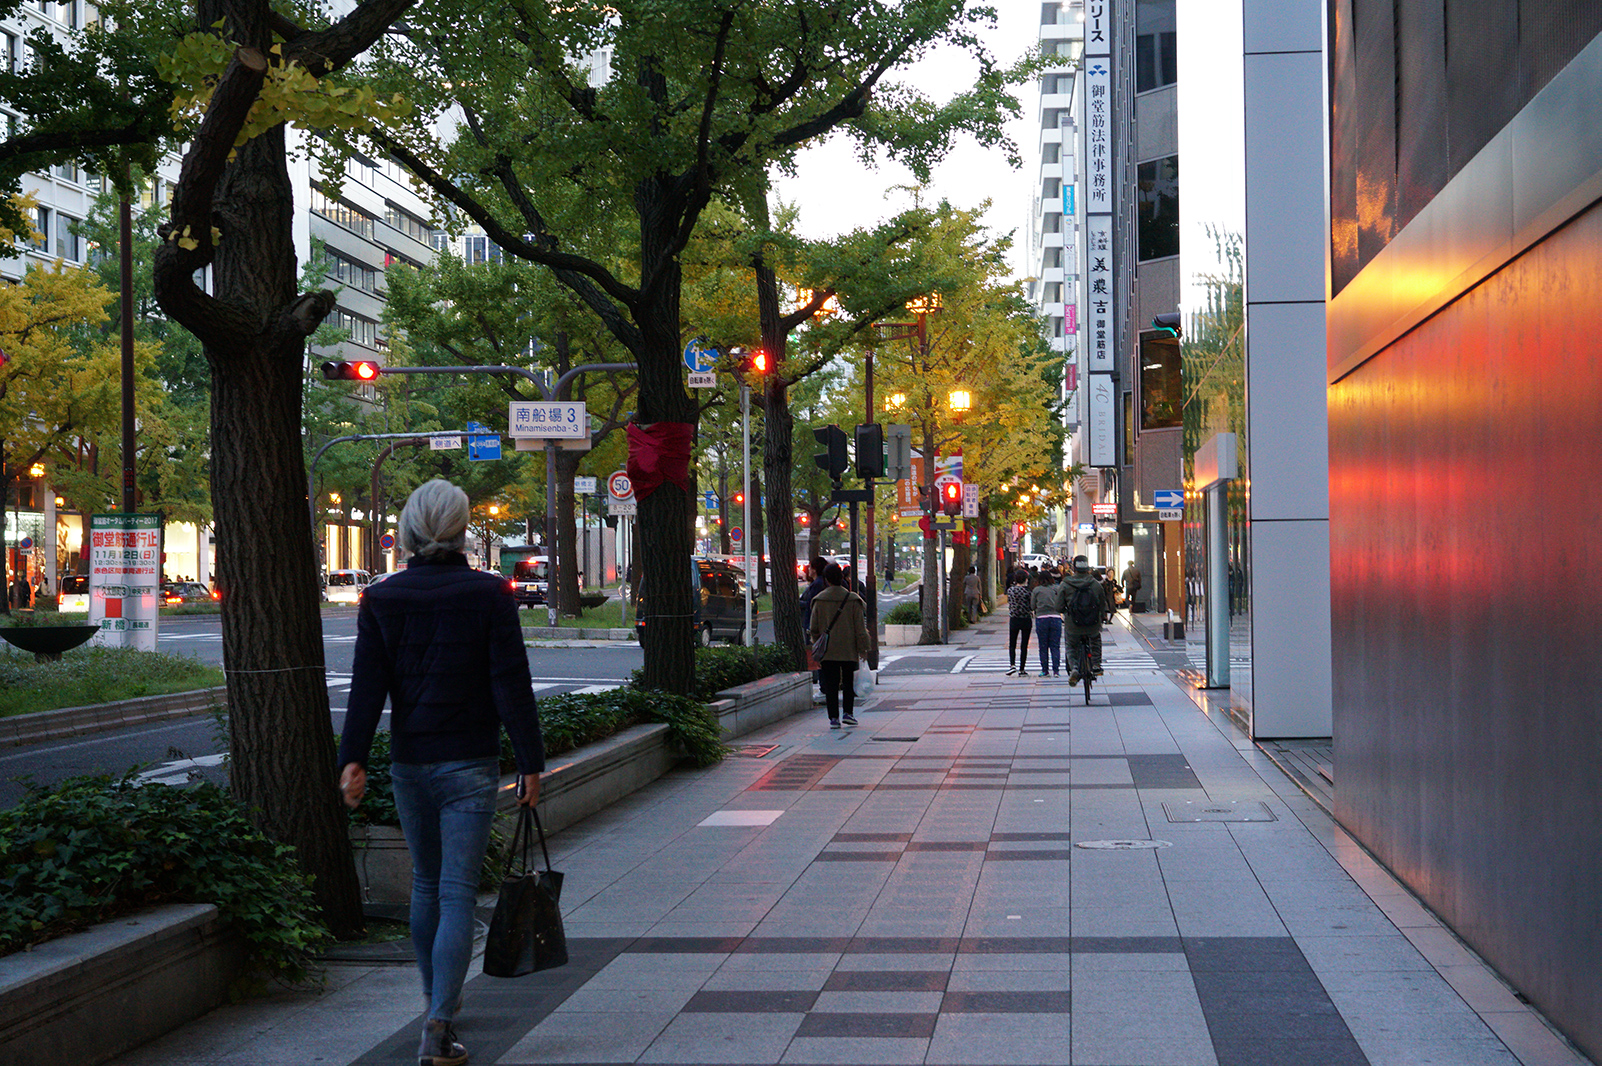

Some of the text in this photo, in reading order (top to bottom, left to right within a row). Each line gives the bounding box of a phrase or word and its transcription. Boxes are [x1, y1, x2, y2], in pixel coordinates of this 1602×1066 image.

[1091, 0, 1105, 43] リース
[1091, 84, 1106, 202] 御堂筋法律事務所
[1096, 319, 1106, 360] 御堂筋店
[516, 407, 576, 423] 南船場 3
[1098, 411, 1106, 458] BRIDAL
[614, 479, 629, 491] 50
[92, 531, 158, 548] 御堂筋通行止
